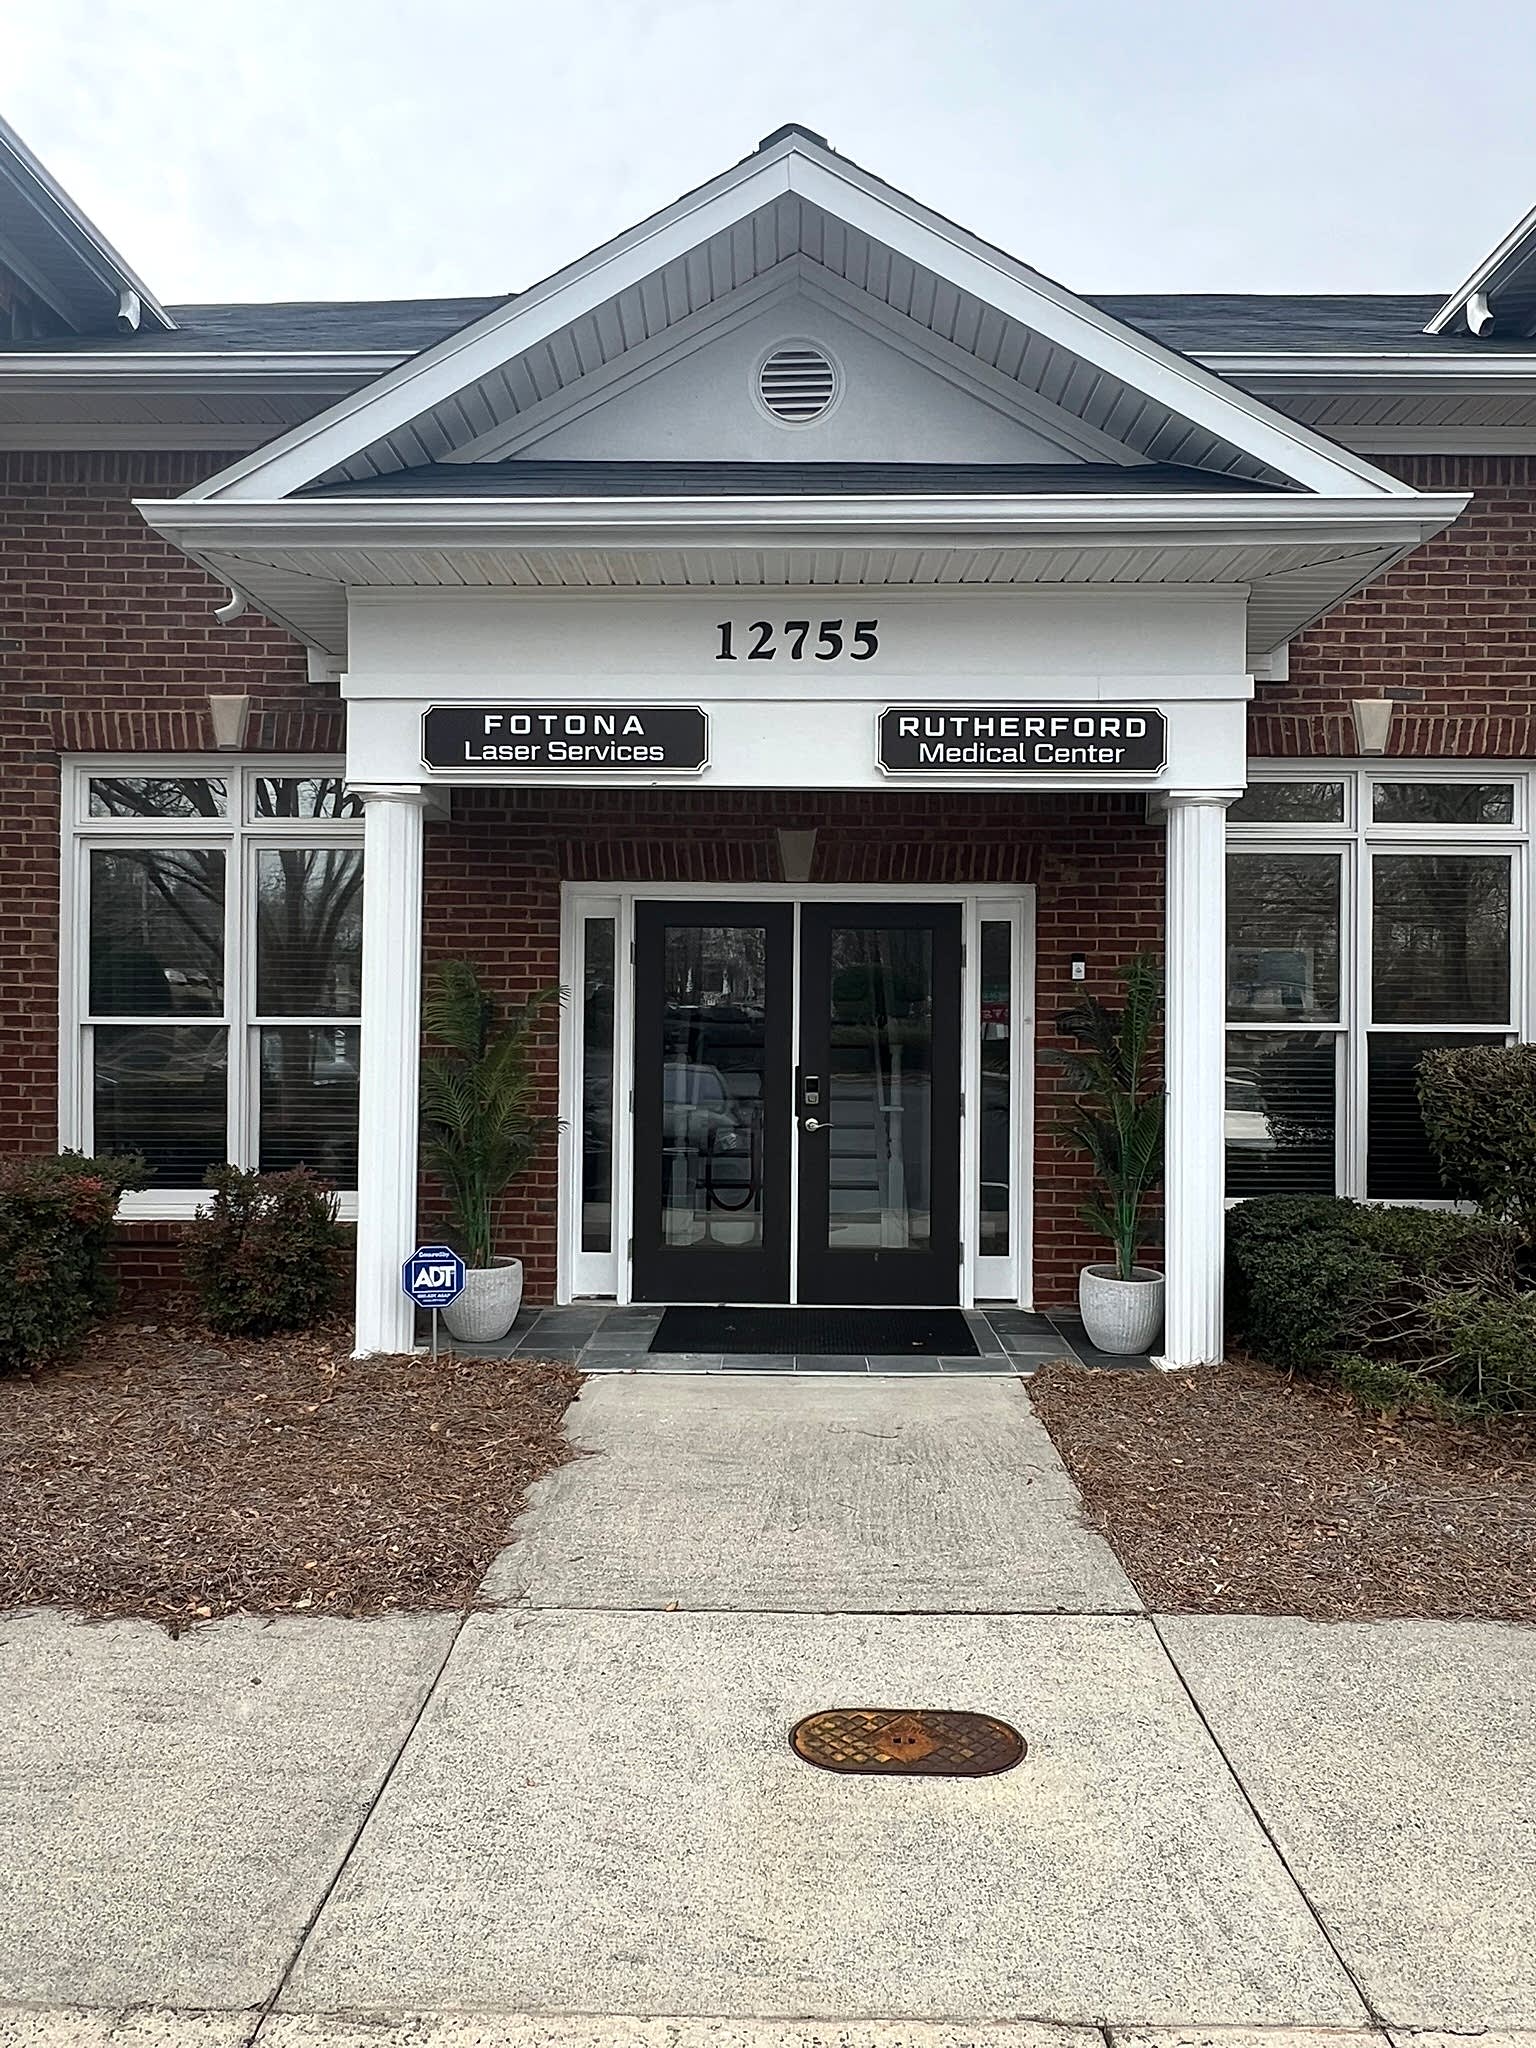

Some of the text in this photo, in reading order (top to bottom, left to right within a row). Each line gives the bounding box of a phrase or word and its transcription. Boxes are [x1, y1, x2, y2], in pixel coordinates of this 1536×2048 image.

[715, 619, 879, 660] 12755
[484, 714, 645, 735] FOTONA
[899, 716, 1147, 738] RUTHERFORD
[464, 740, 665, 762] Laser Services
[918, 742, 1126, 764] Medical Center
[414, 1265, 455, 1288] ADT
